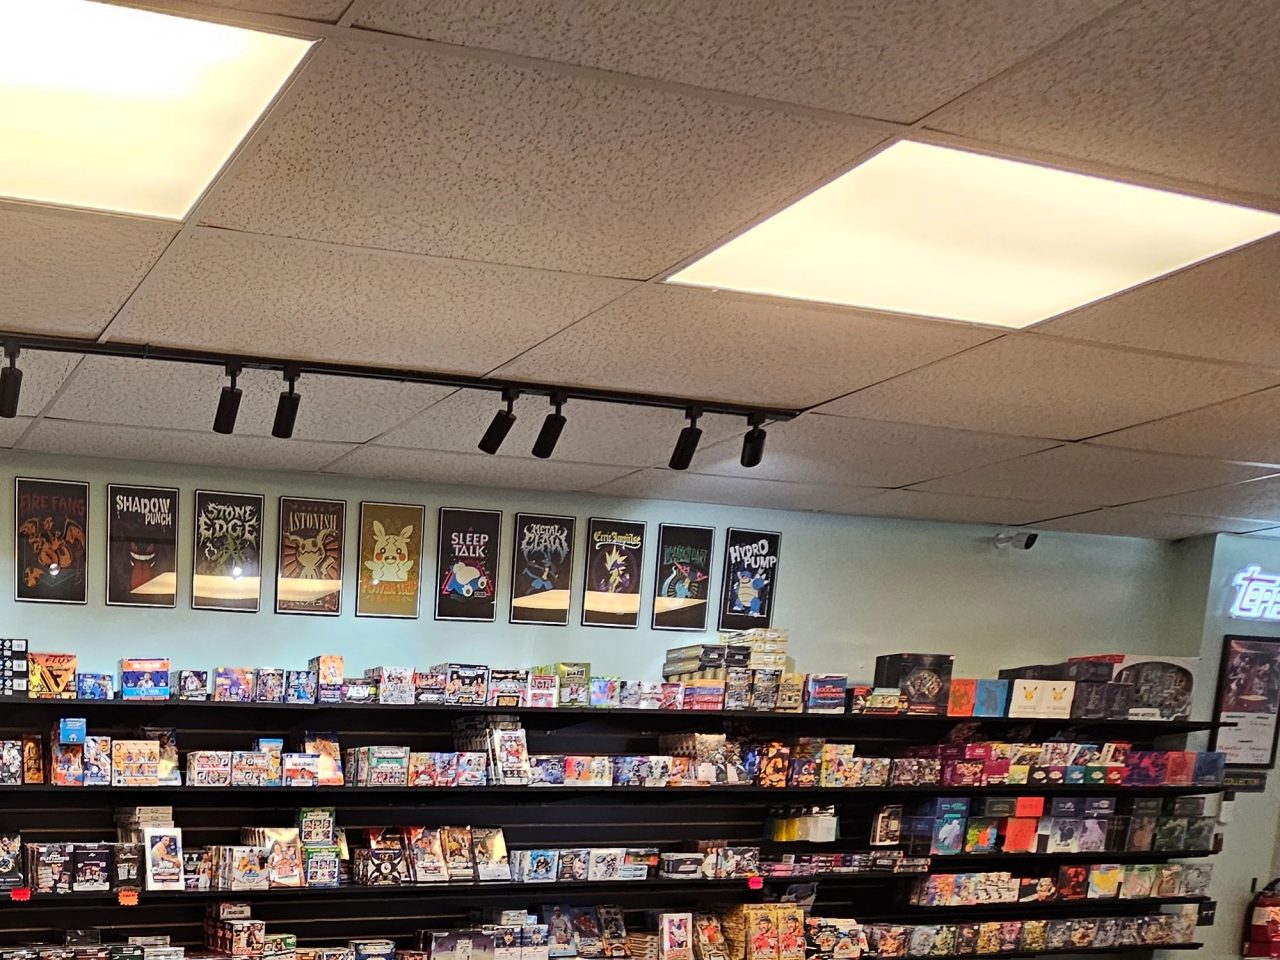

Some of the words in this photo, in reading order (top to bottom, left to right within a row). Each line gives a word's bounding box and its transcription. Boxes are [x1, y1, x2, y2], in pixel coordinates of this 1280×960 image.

[116, 494, 171, 513] SHADOW
[206, 502, 257, 520] STONE
[144, 511, 172, 527] PUNCH
[289, 511, 337, 532] ASTONISH
[198, 517, 259, 543] EDGE
[529, 522, 563, 536] METAL
[451, 532, 490, 545] SLEEP
[521, 532, 571, 552] CLAW
[452, 543, 486, 558] TALK
[729, 539, 770, 564] HYDRO
[744, 555, 777, 569] PUMP
[45, 656, 72, 665] FLUX
